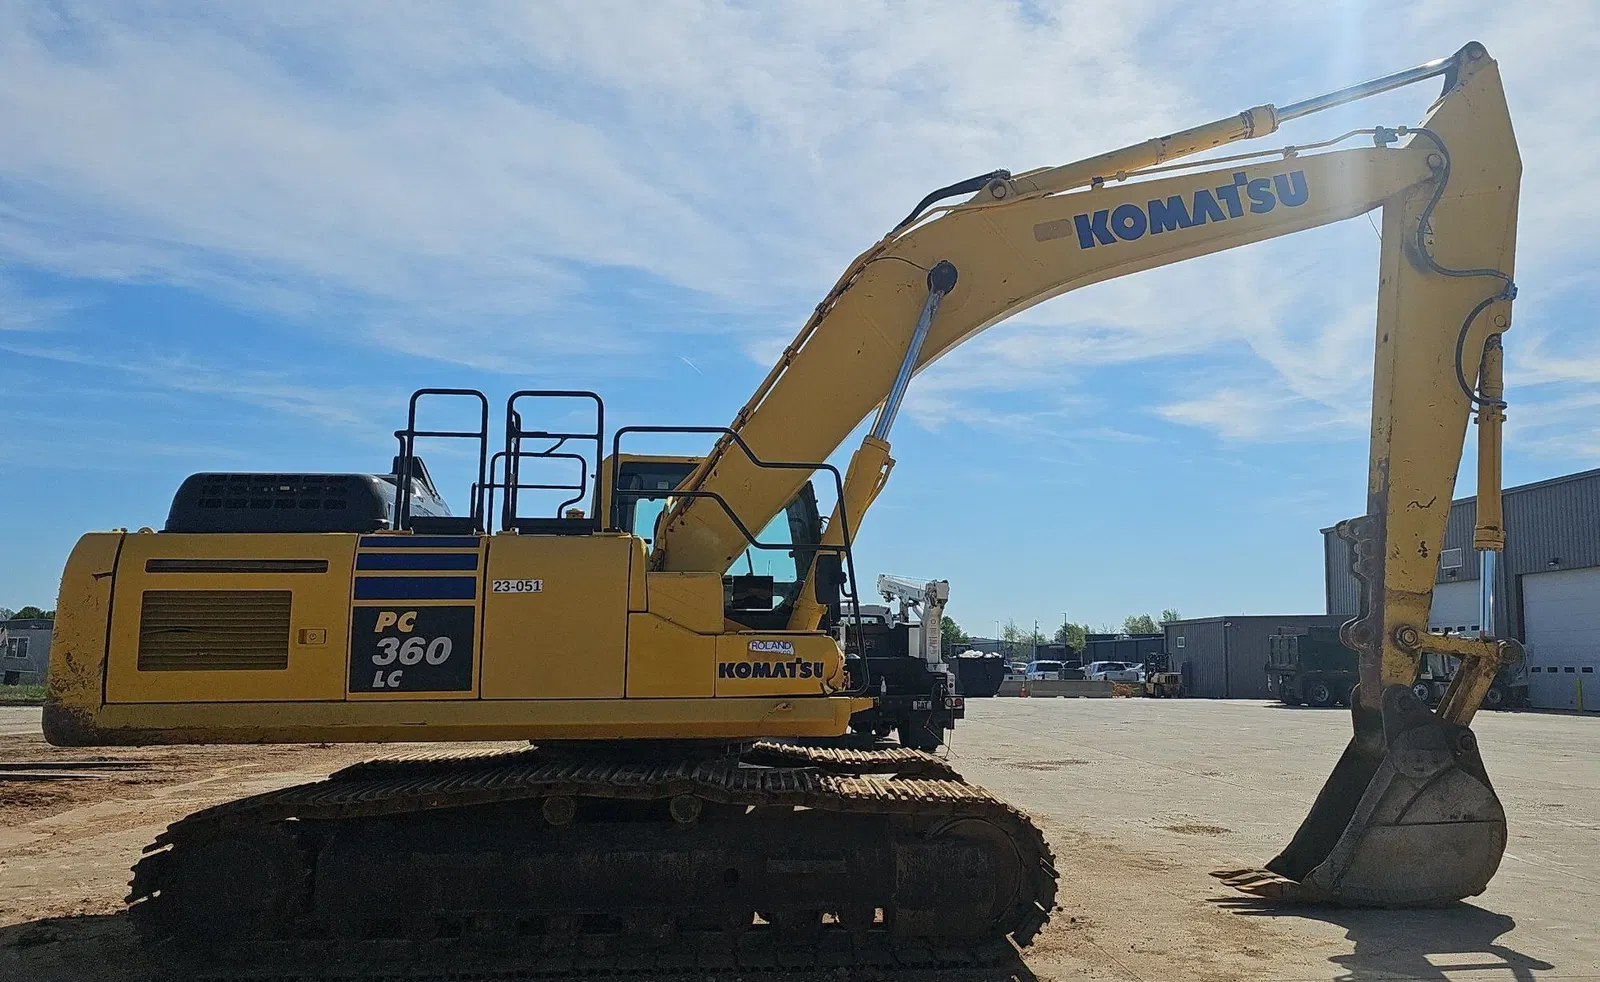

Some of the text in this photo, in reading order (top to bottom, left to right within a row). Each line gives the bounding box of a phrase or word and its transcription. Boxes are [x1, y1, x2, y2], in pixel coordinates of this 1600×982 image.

[1073, 170, 1310, 249] KOMATSU
[494, 580, 541, 592] 23-051
[374, 611, 417, 633] PC
[371, 636, 453, 666] 360
[751, 641, 792, 650] ROLAND
[372, 670, 403, 688] LC
[718, 657, 824, 679] KOMATSU
